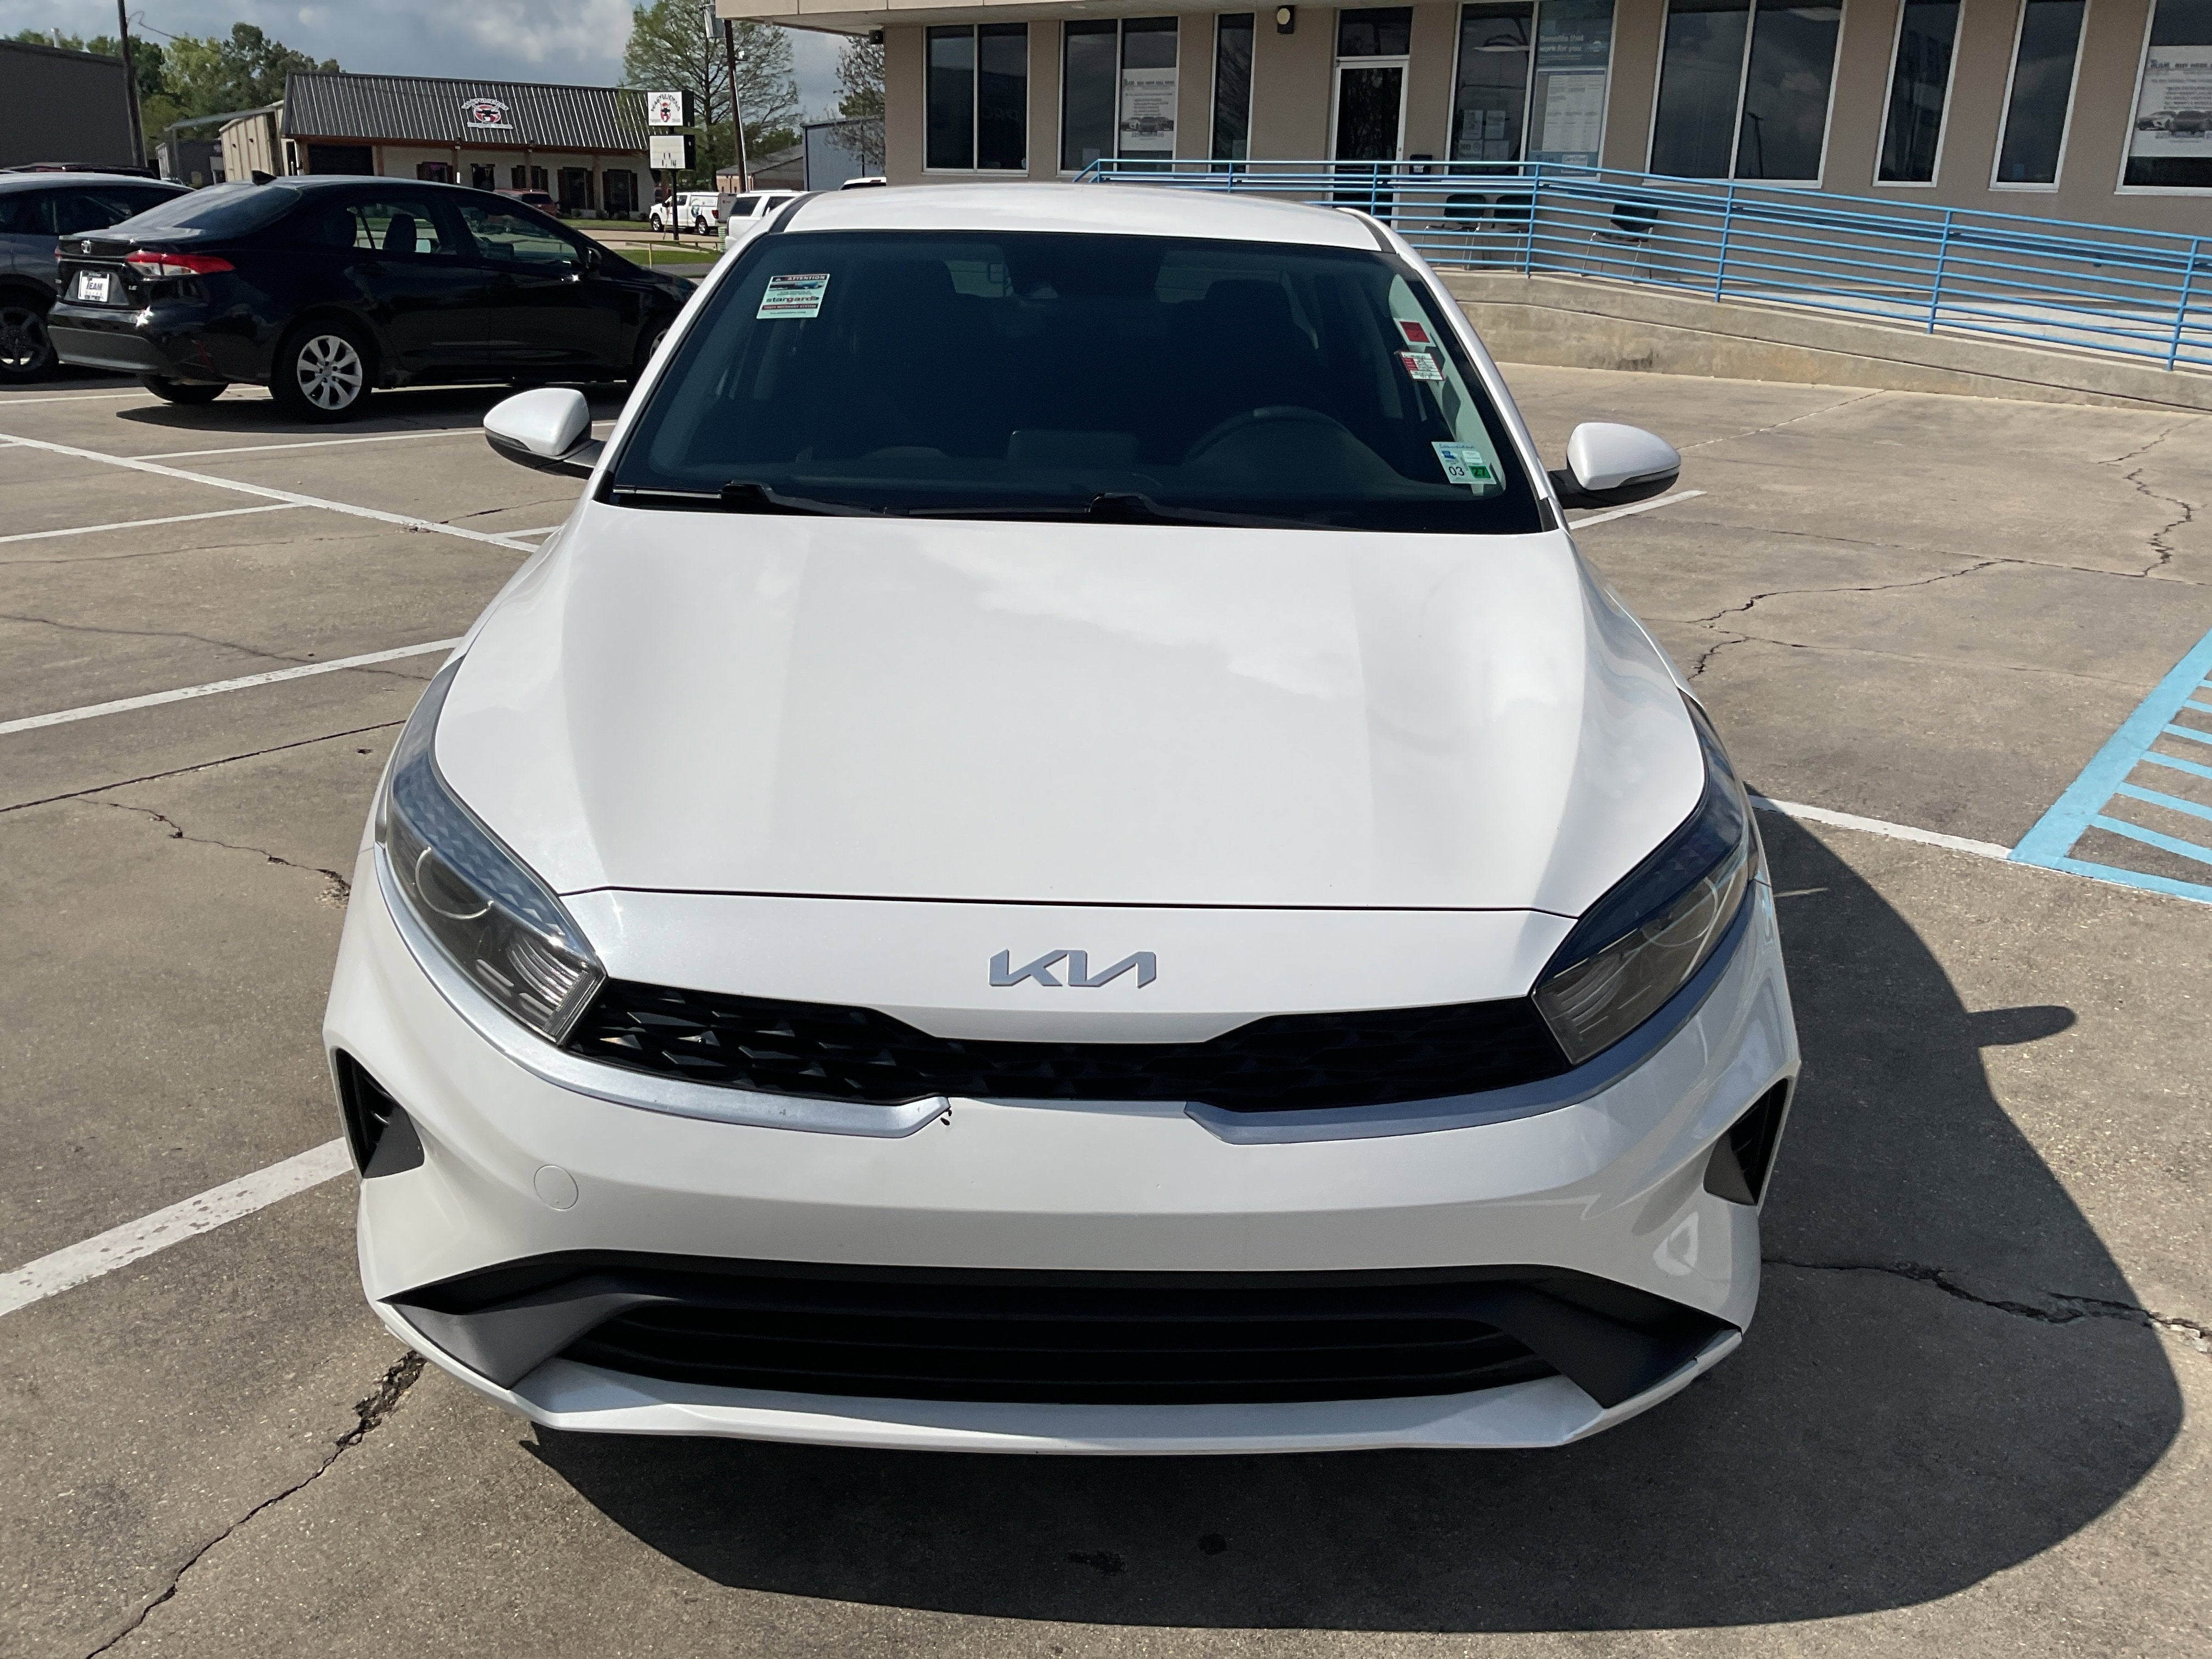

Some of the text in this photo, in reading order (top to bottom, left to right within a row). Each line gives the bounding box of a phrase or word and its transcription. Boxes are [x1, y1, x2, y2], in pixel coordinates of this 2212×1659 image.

[1449, 466, 1486, 477] 03 27
[989, 949, 1157, 989] KIA
